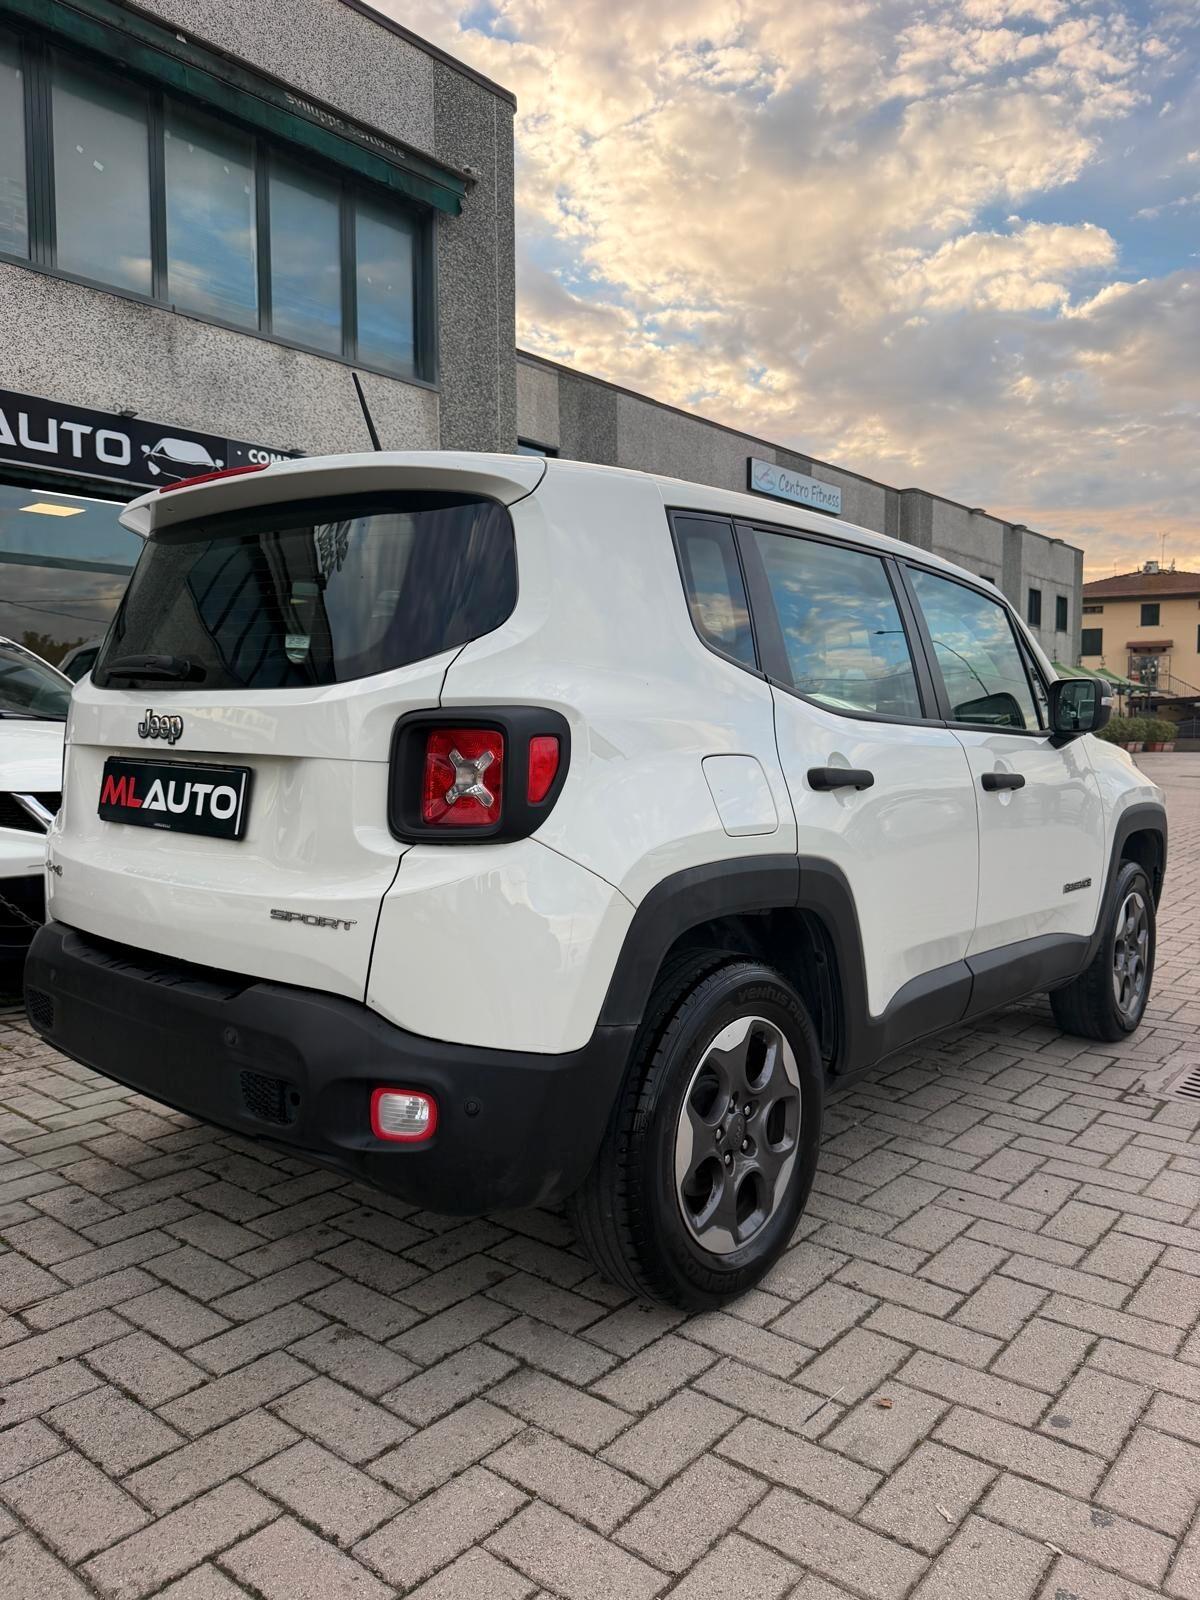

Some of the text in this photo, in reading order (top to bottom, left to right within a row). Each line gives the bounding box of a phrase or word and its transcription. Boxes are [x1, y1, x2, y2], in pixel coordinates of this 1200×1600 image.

[778, 474, 840, 508] Centro Fitness
[138, 709, 183, 745] Jeep
[270, 908, 358, 931] SPORT
